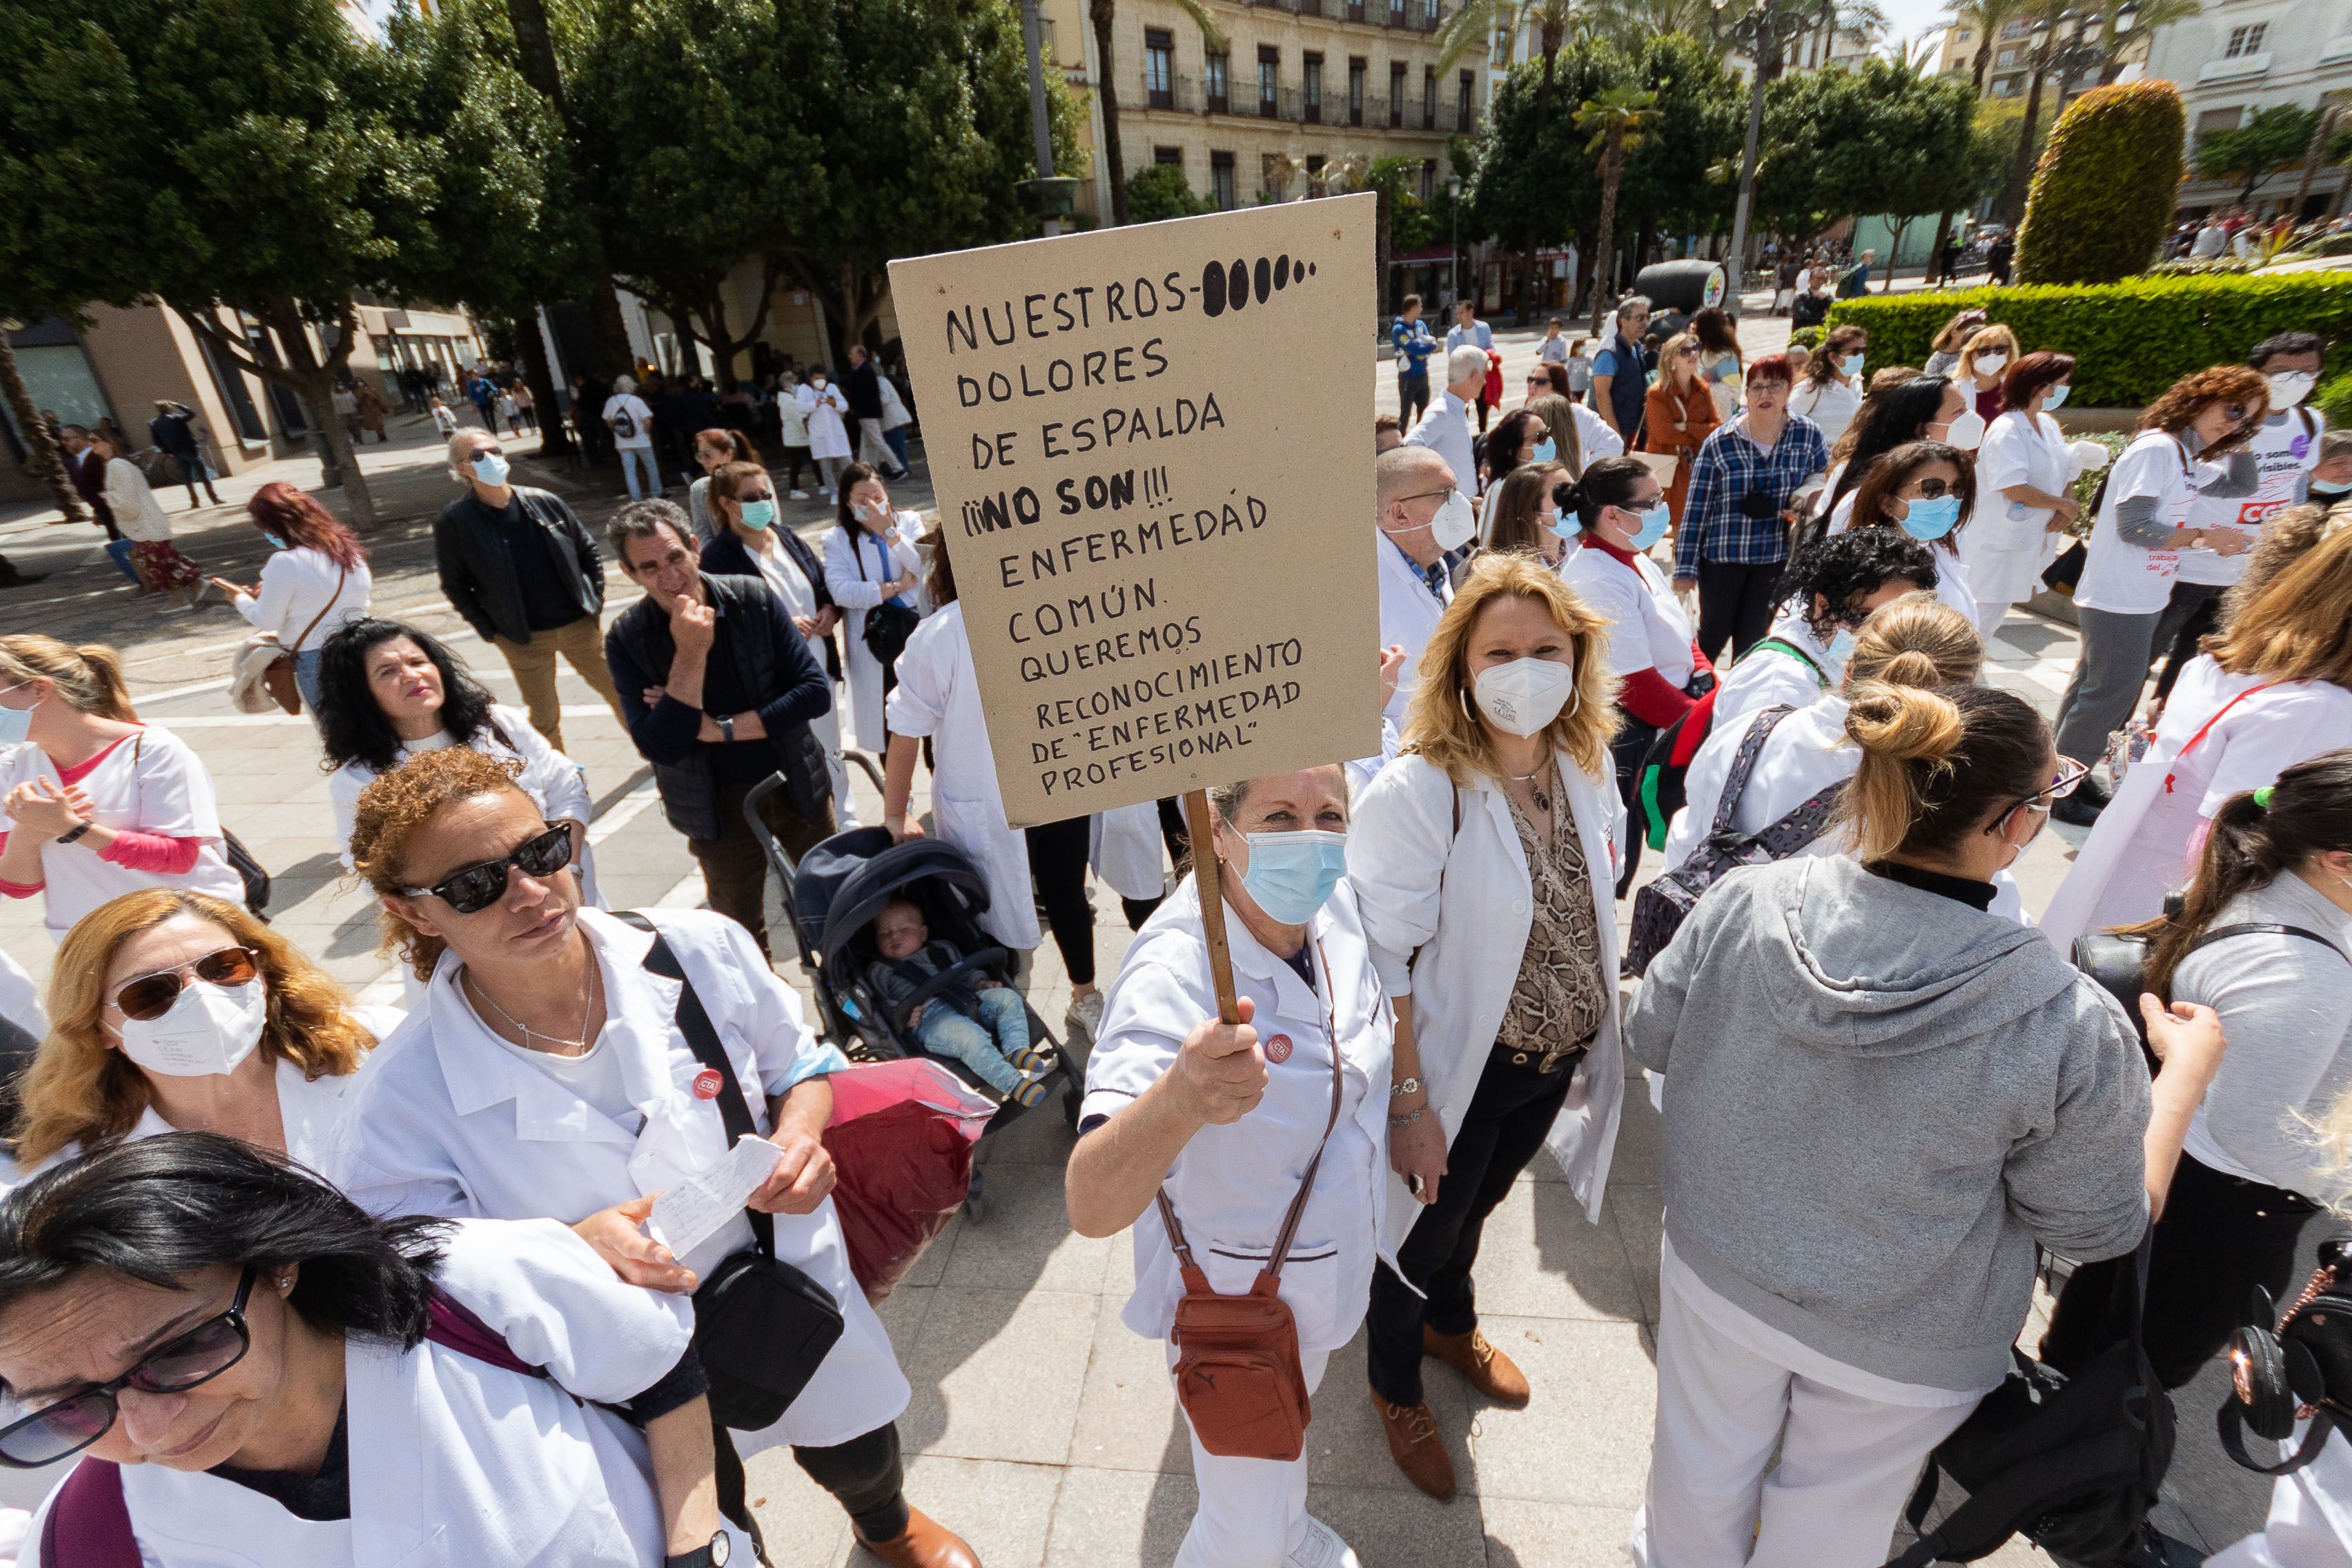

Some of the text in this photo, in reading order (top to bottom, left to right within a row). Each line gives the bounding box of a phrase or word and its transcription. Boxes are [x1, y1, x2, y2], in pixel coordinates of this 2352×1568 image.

[957, 338, 1168, 409] DOLORES
[972, 392, 1225, 470] DE ESPALDA
[1021, 616, 1202, 683] QUEREMOS
[1036, 638, 1302, 729] RECONOCIMIENTO
